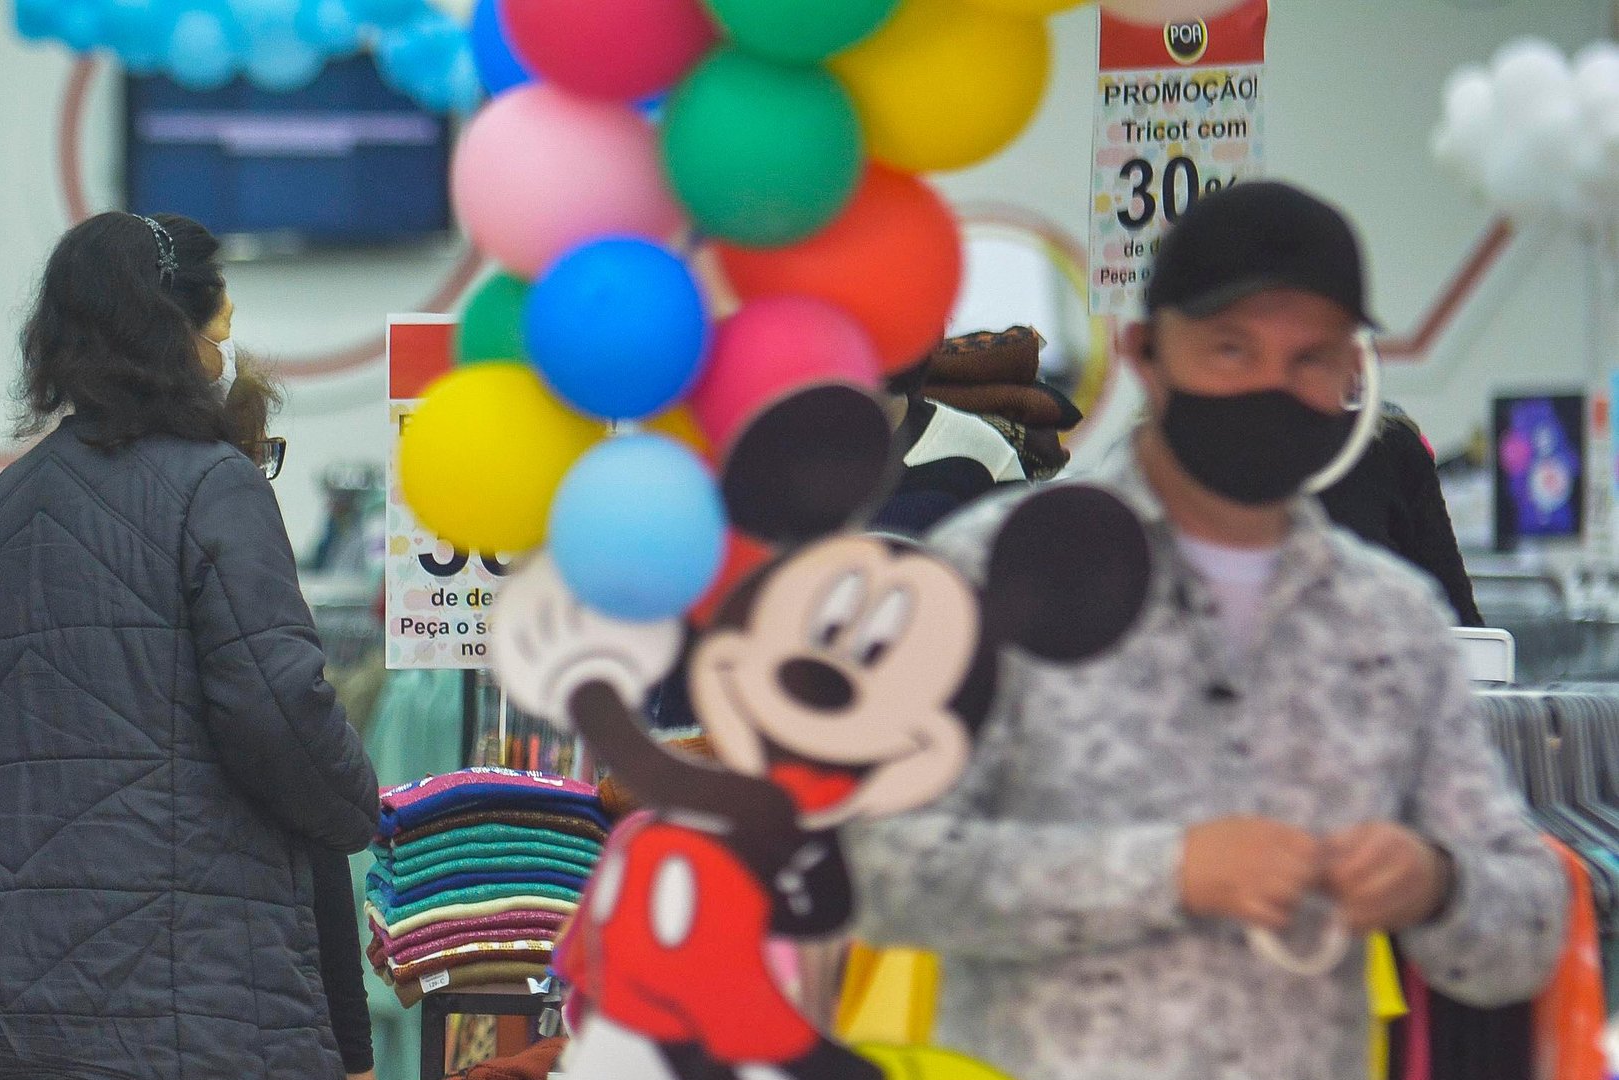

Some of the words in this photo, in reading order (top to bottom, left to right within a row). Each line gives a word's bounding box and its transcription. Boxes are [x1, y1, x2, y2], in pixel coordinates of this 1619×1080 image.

[1170, 23, 1203, 45] POA
[1104, 74, 1258, 107] PROMOÇÃO!
[1121, 119, 1190, 143] Tricot
[1197, 119, 1248, 140] com
[1123, 238, 1144, 258] de
[431, 587, 459, 607] de
[466, 587, 494, 607] de
[400, 617, 450, 639] Peça
[456, 622, 470, 635] o
[461, 643, 487, 656] no
